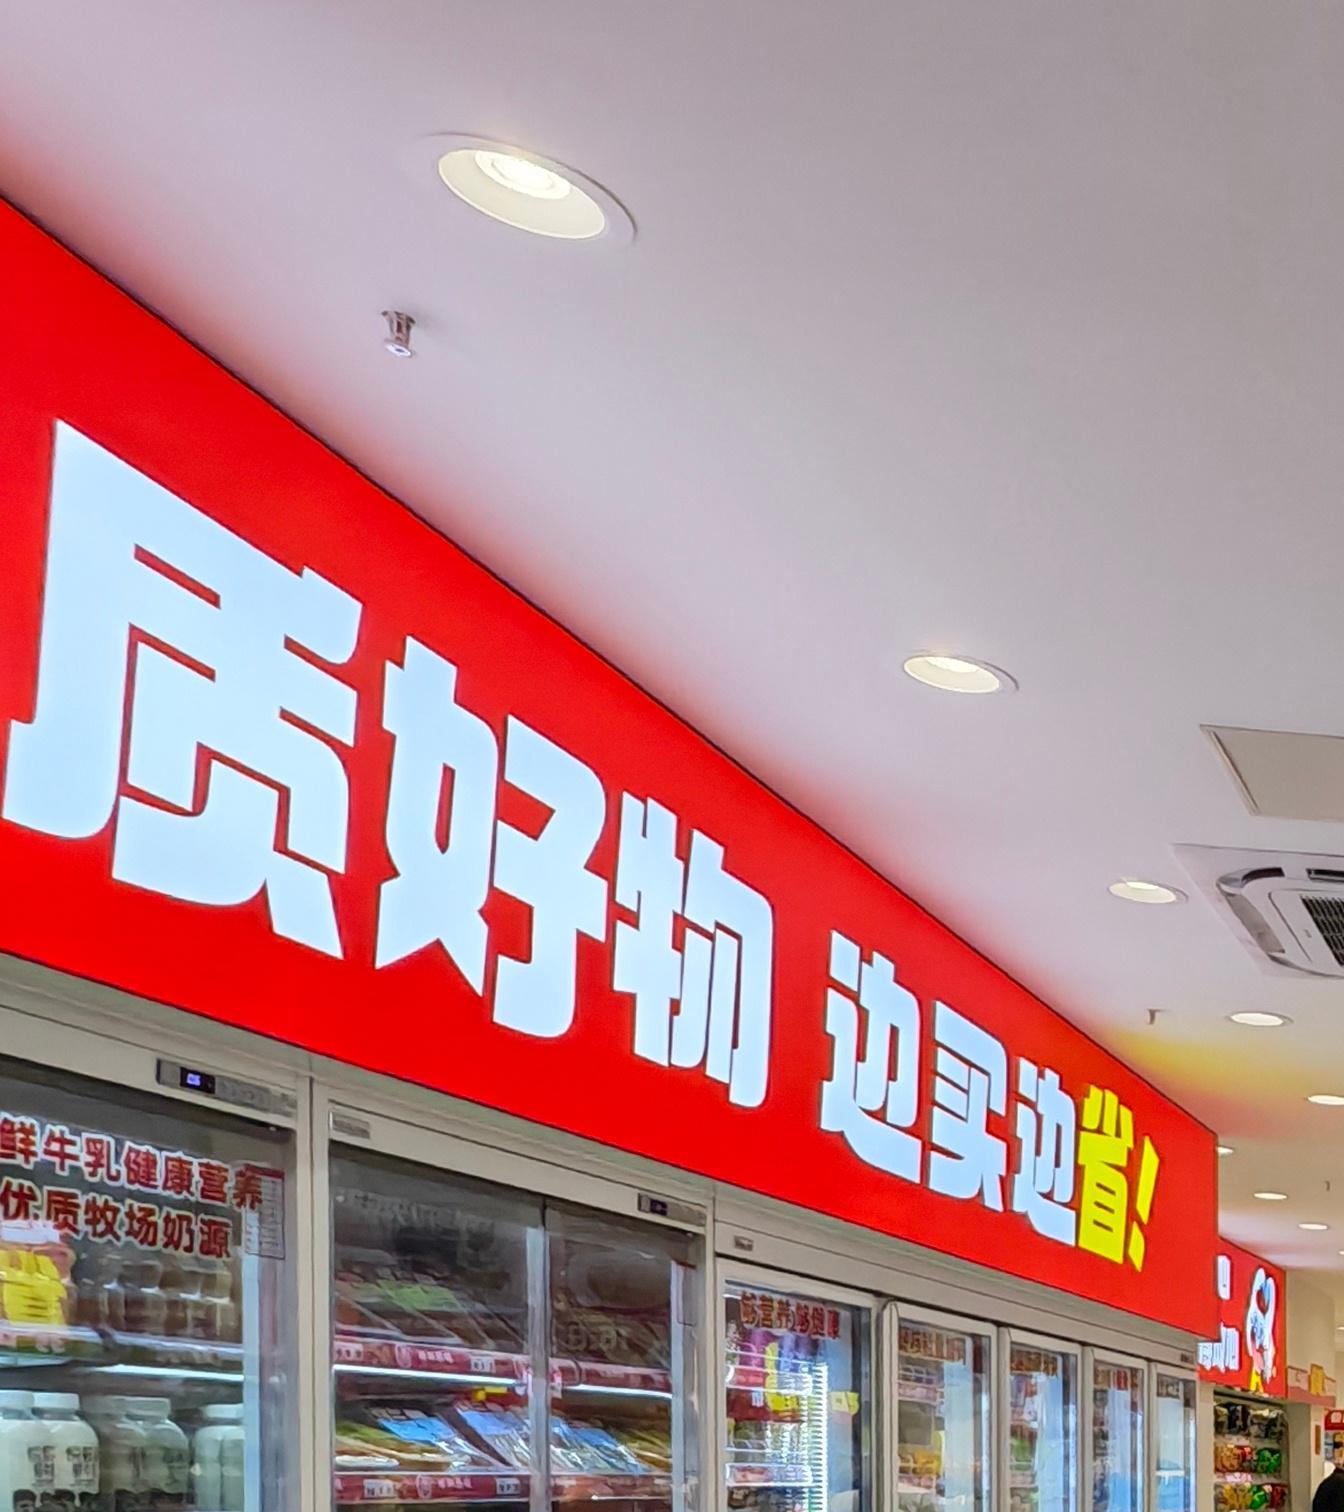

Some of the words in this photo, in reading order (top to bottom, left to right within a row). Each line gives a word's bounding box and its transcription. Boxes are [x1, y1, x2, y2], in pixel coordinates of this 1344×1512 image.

[2, 418, 774, 1109] 质好物
[818, 929, 1160, 1273] 边买边省!
[1, 1177, 232, 1258] 优质牧场奶源
